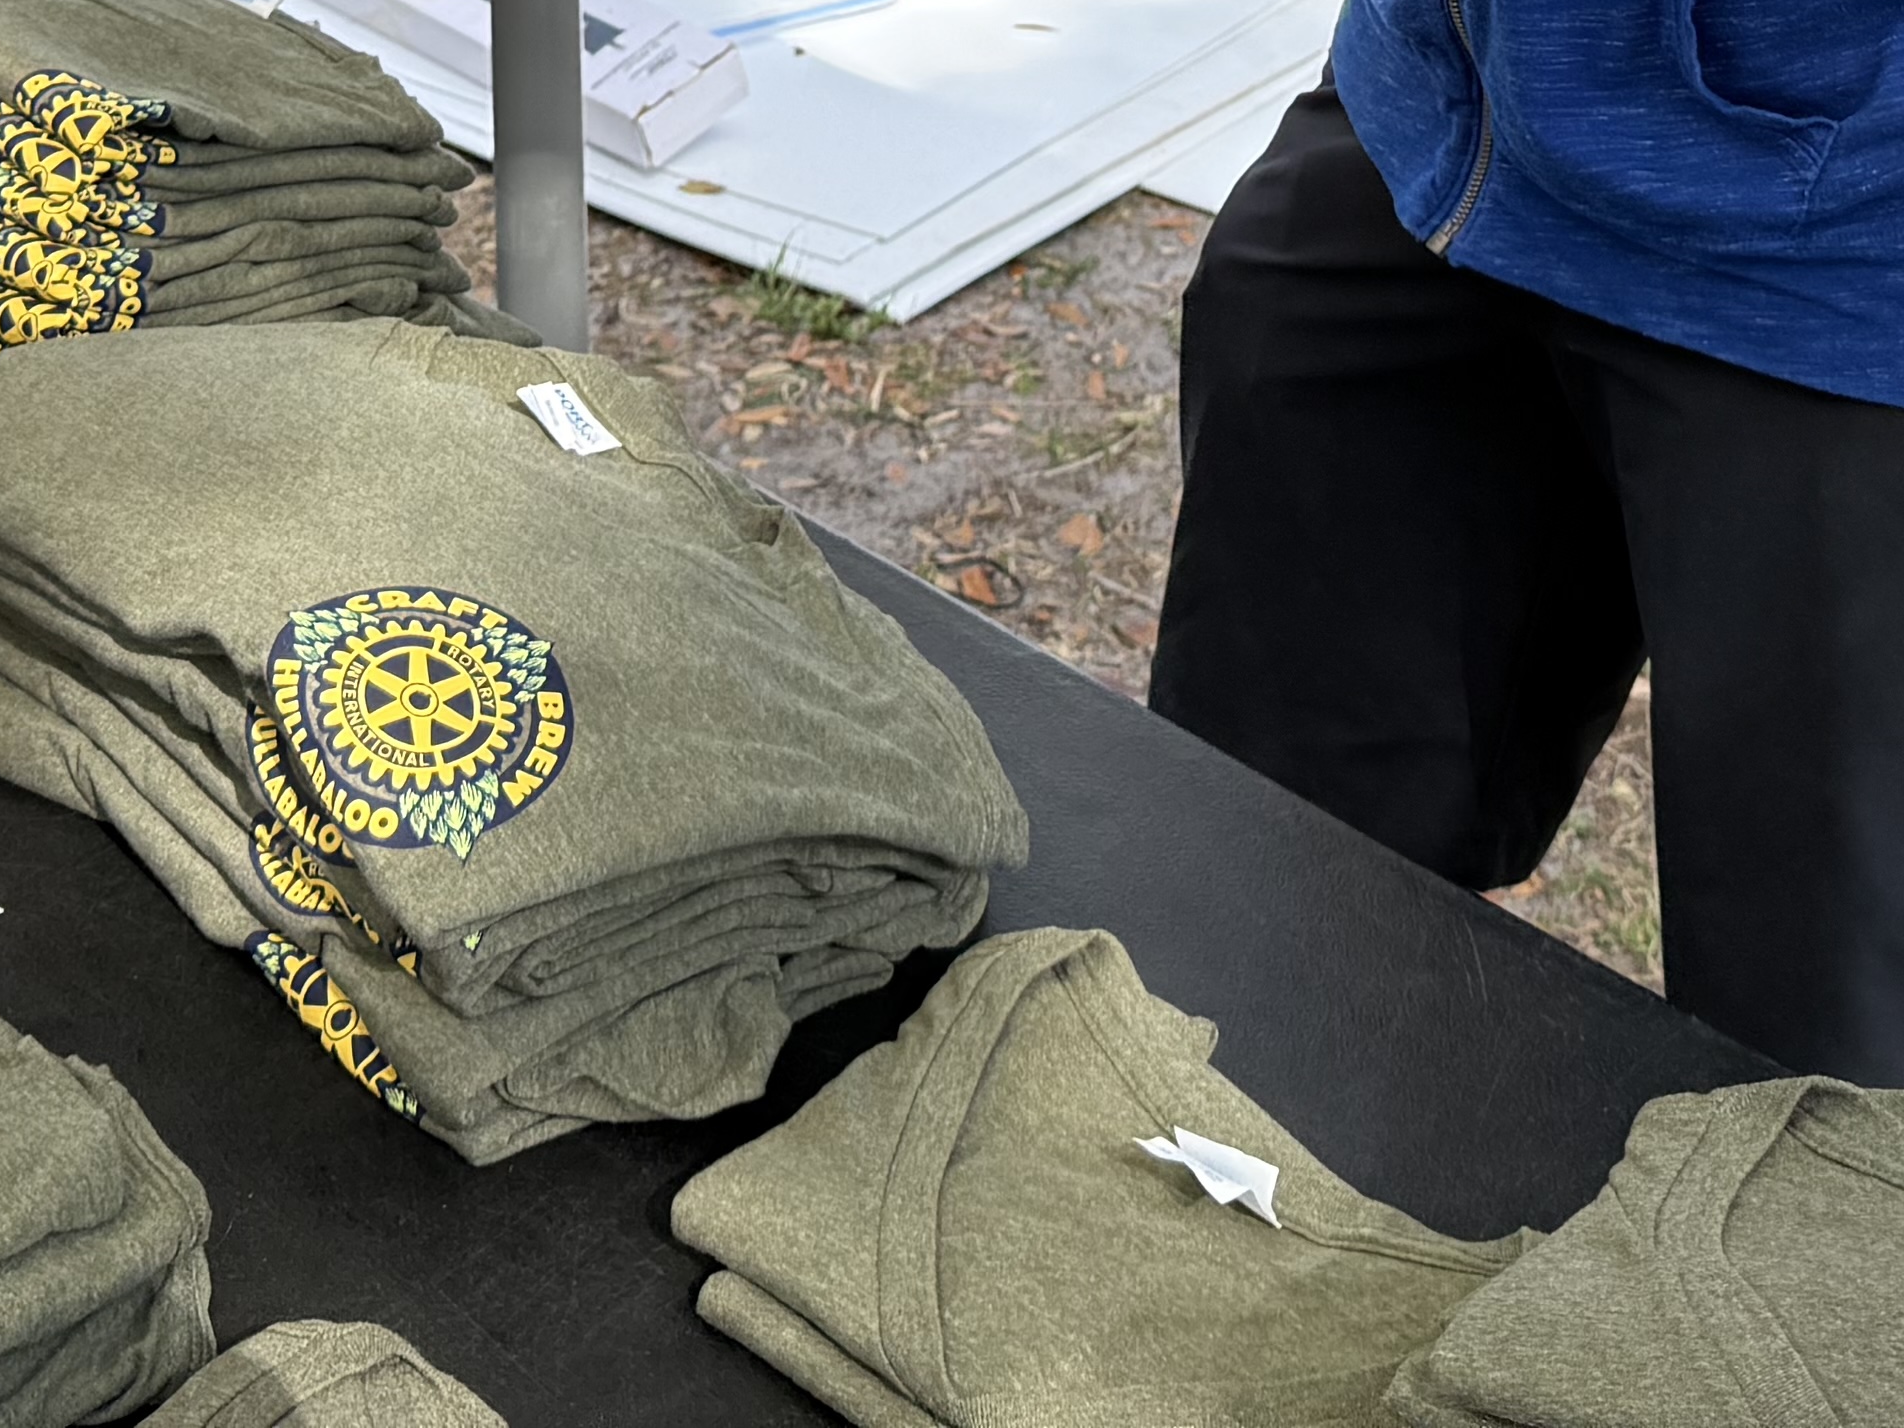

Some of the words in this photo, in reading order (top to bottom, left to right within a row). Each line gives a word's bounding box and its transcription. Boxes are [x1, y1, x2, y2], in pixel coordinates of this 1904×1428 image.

[345, 590, 508, 630] CRAFT
[342, 661, 430, 767] INTERNATIONAL
[447, 645, 496, 710] ROTARY
[251, 708, 348, 855] ULLABALO
[272, 659, 399, 840] HULLABALOO
[501, 691, 567, 807] BREW
